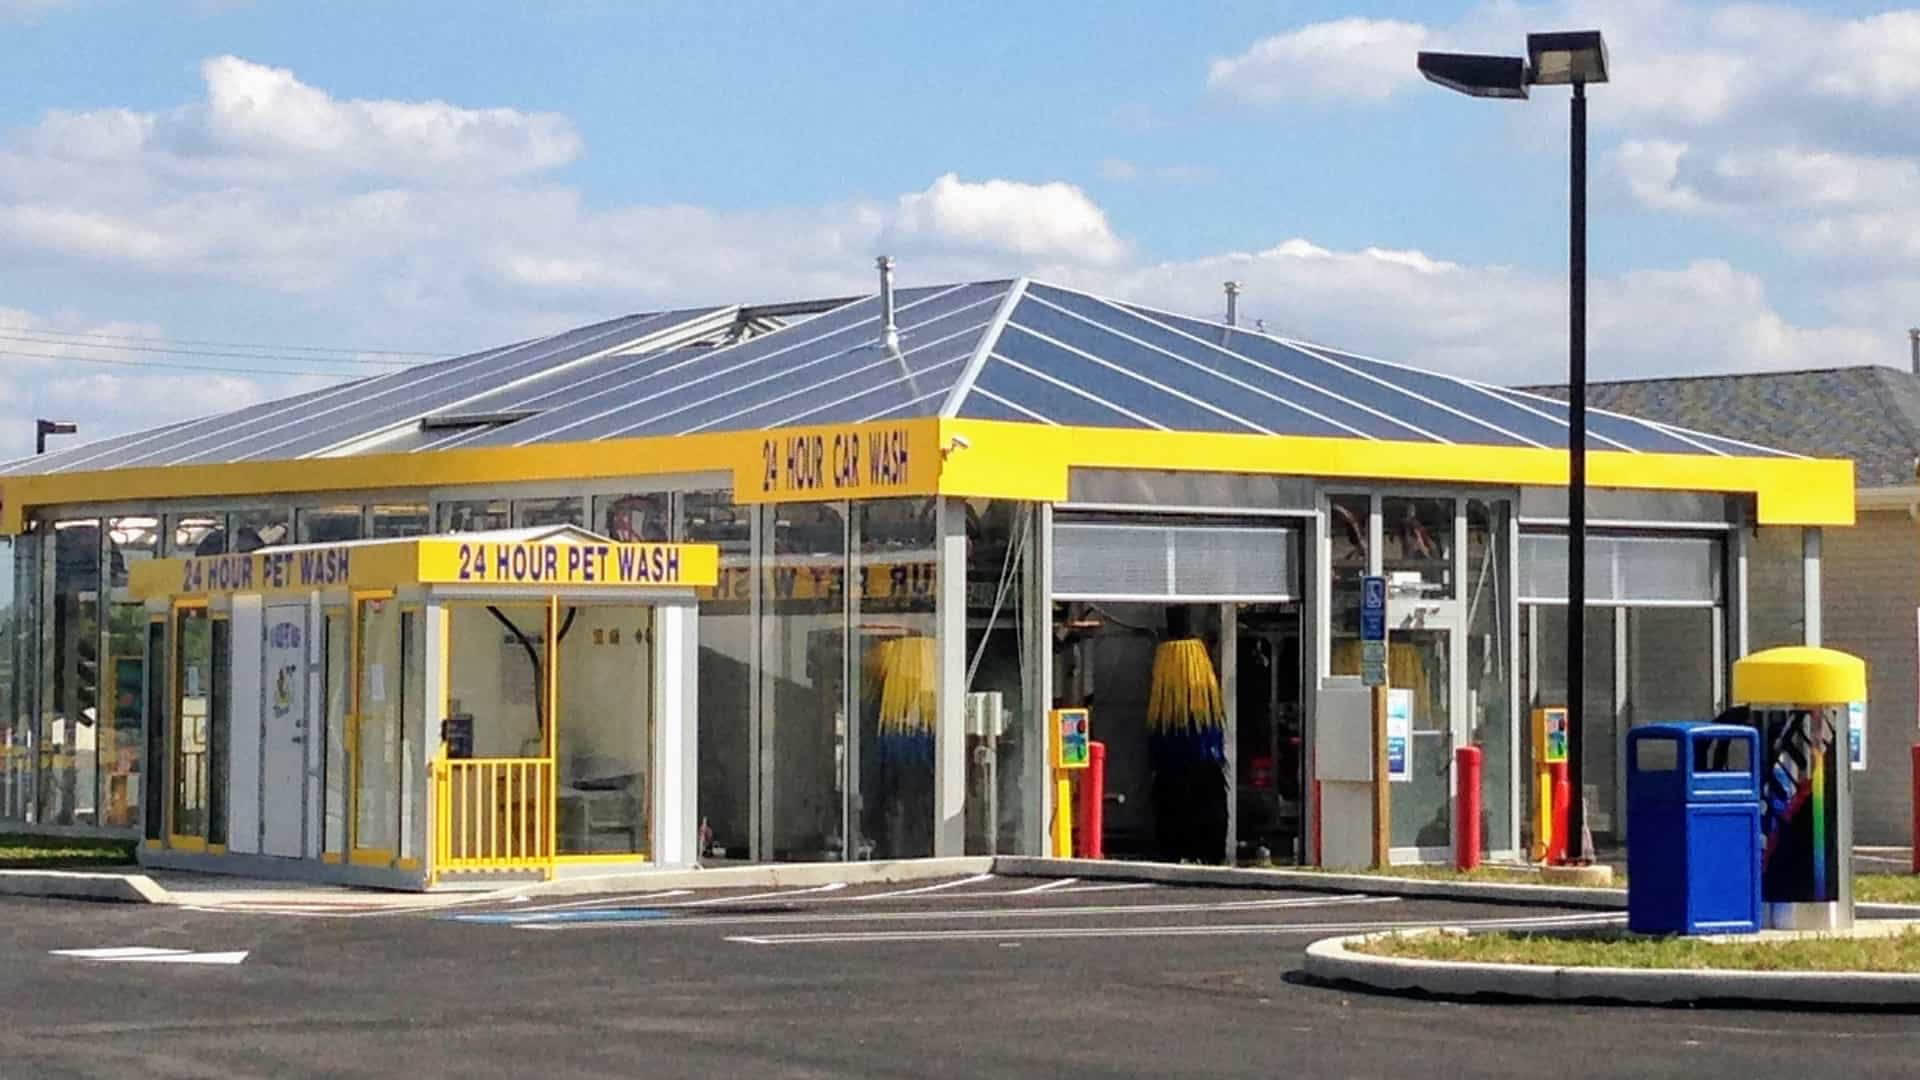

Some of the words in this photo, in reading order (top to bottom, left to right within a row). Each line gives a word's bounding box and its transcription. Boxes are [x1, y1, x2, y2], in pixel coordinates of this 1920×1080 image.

[762, 439, 778, 492] 24
[787, 434, 824, 490] HOUR
[833, 433, 860, 488] CAR
[869, 429, 909, 486] WASH
[183, 558, 203, 592] 24
[207, 555, 252, 590] HOUR
[264, 552, 294, 588] PET
[301, 548, 350, 585] WASH
[459, 543, 487, 580] 24
[496, 544, 558, 581] HOUR
[568, 545, 609, 582] PET
[617, 546, 679, 583] WASH
